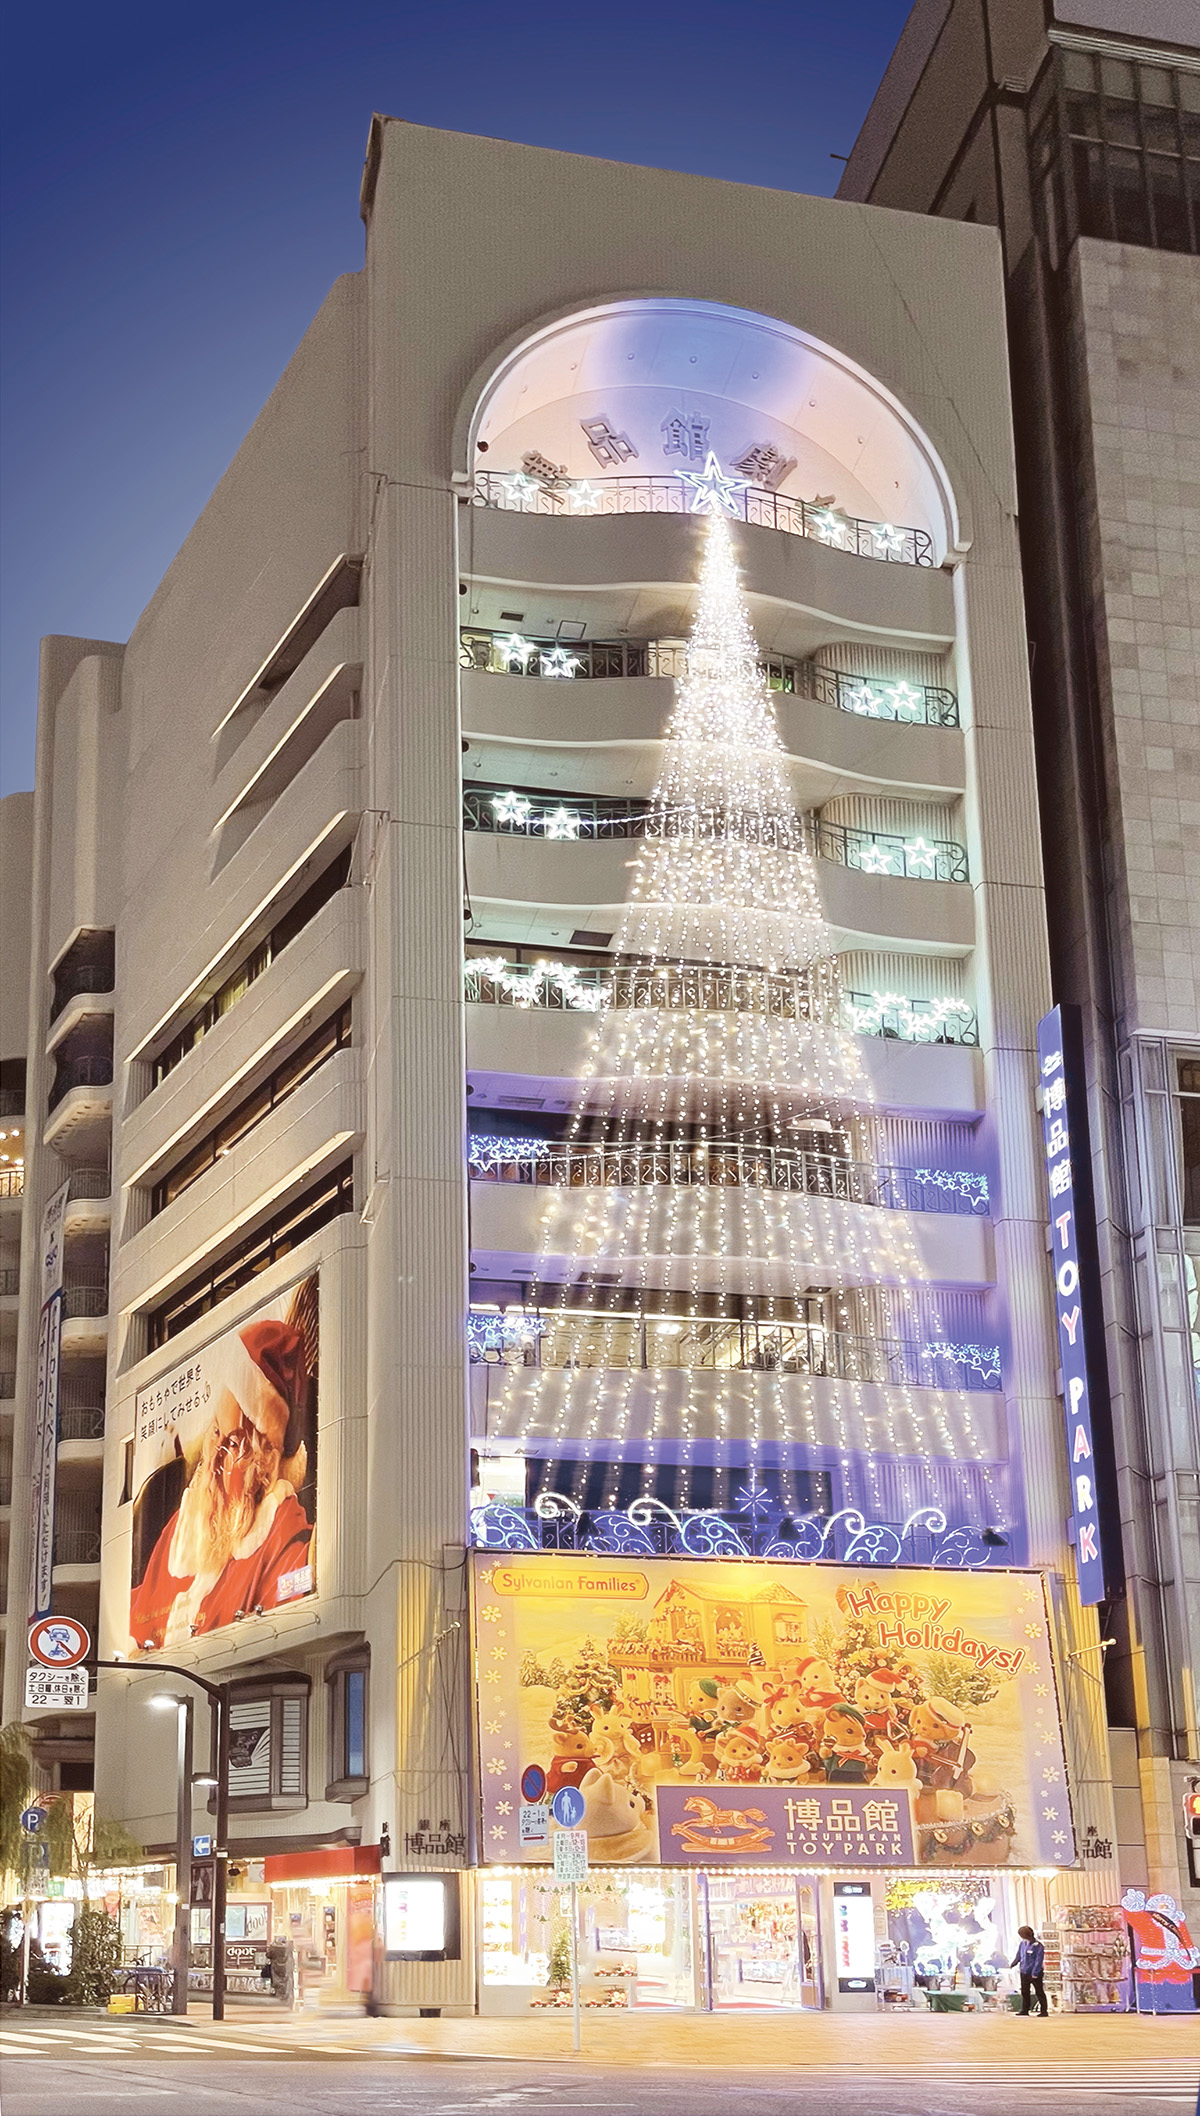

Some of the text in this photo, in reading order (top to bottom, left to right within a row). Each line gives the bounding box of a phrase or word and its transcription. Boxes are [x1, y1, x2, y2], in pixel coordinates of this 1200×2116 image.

[1043, 1077, 1072, 1199] 博品館
[1069, 1376, 1098, 1563] PARK
[502, 1573, 573, 1591] Sylvanian
[846, 1588, 951, 1623] Happy
[878, 1620, 1026, 1675] Holidays!
[27, 1813, 39, 1830] P
[784, 1798, 899, 1832] 博品館
[404, 1832, 466, 1857] 博品館
[786, 1832, 901, 1842] HAKUHINKAN
[786, 1843, 903, 1856] TOY PARK
